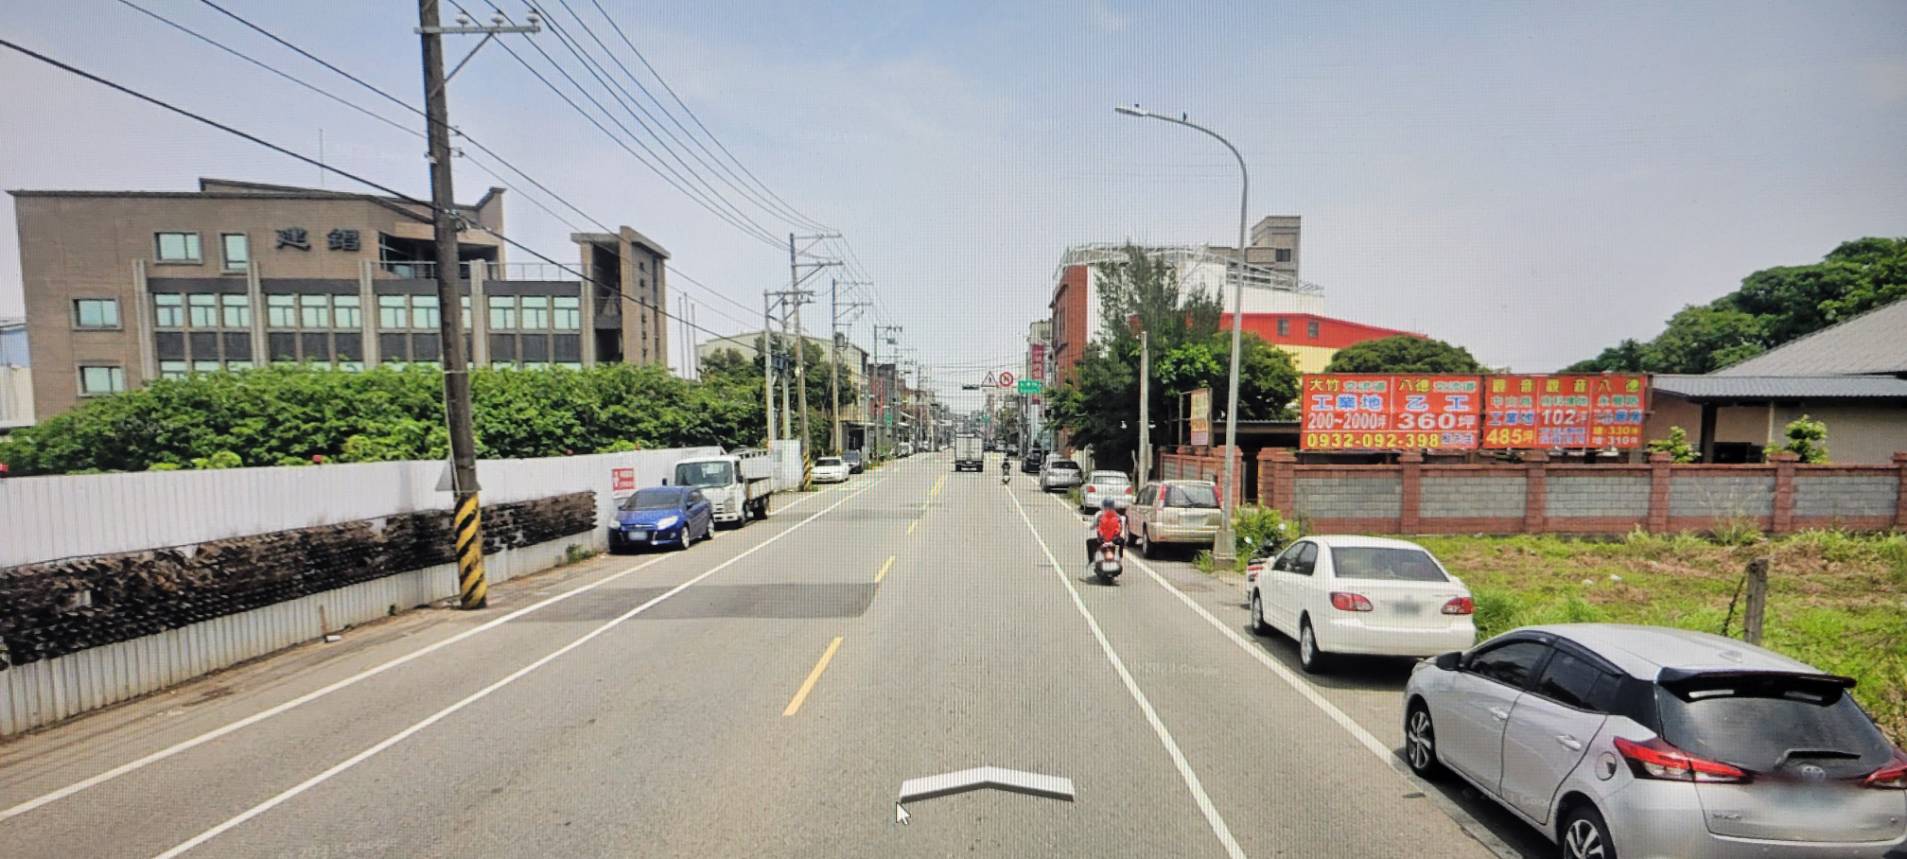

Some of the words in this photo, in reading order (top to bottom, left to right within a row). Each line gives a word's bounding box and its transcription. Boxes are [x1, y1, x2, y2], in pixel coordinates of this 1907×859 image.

[1309, 379, 1339, 392] 大竹
[1311, 394, 1383, 411] 工業地
[1397, 413, 1476, 430] 360坪
[1307, 433, 1440, 448] 0932-092-398
